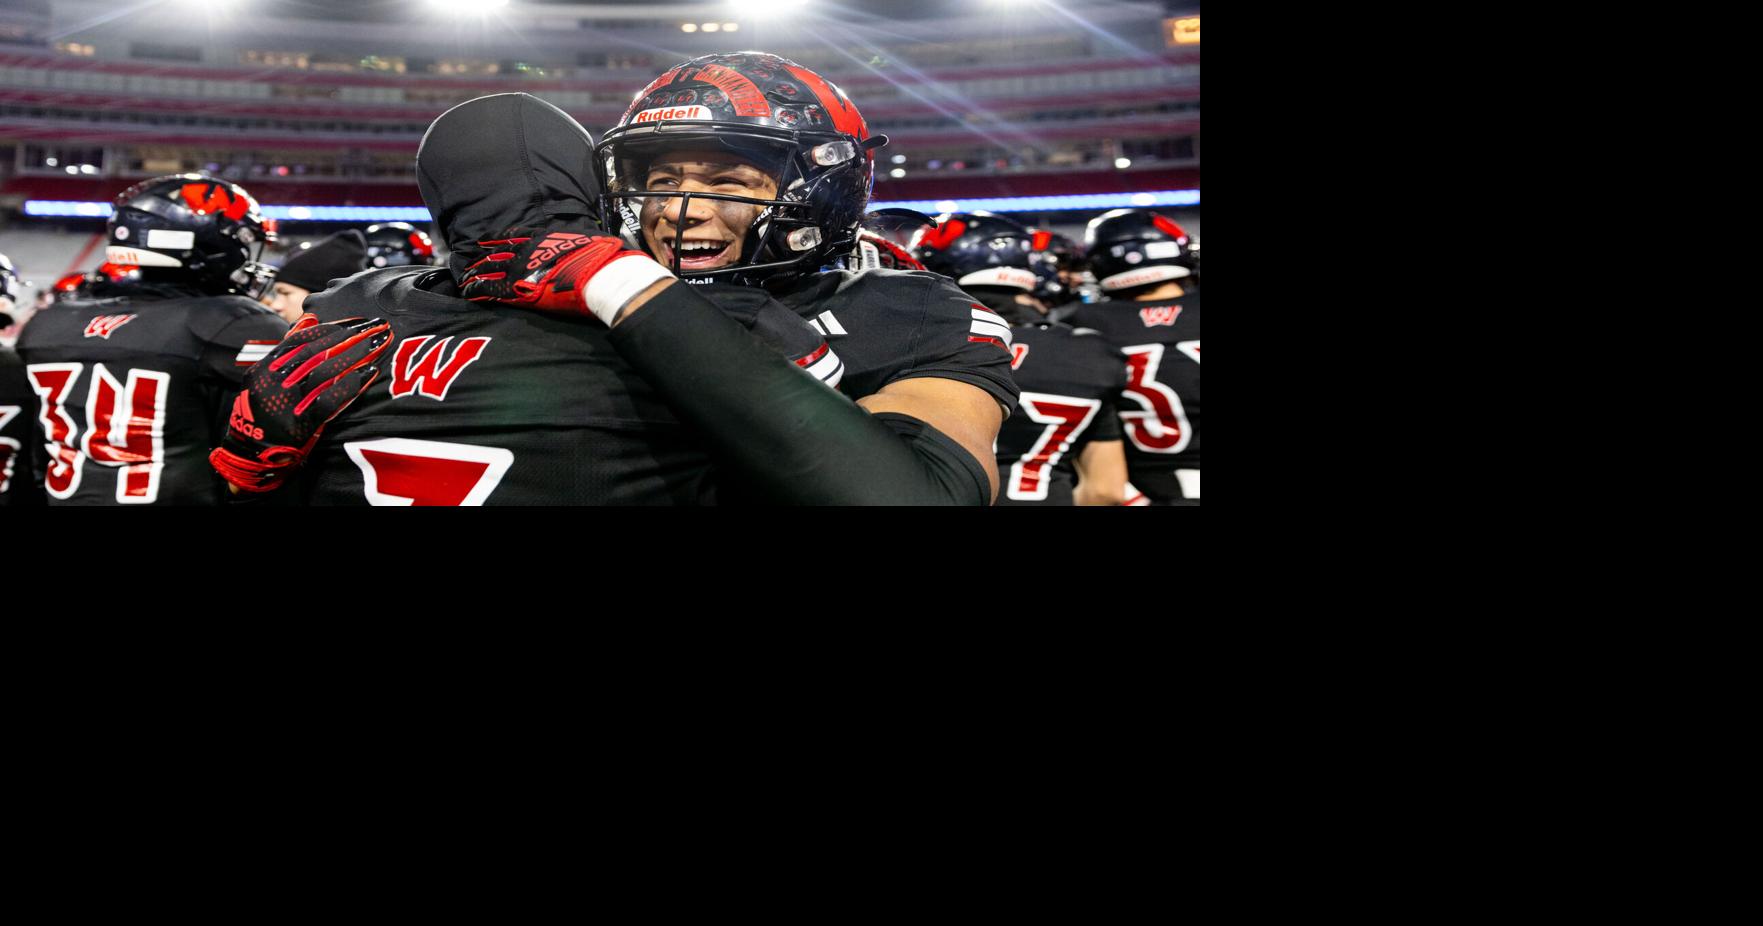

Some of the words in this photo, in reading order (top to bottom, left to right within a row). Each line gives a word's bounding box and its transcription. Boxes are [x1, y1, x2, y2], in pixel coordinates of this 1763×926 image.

[636, 106, 700, 122] Riddell
[527, 236, 592, 270] adida
[83, 313, 139, 340] W
[1139, 305, 1183, 328] W
[389, 335, 492, 401] W
[1118, 340, 1200, 456] 3
[26, 362, 171, 504] 34
[994, 391, 1102, 501] 7
